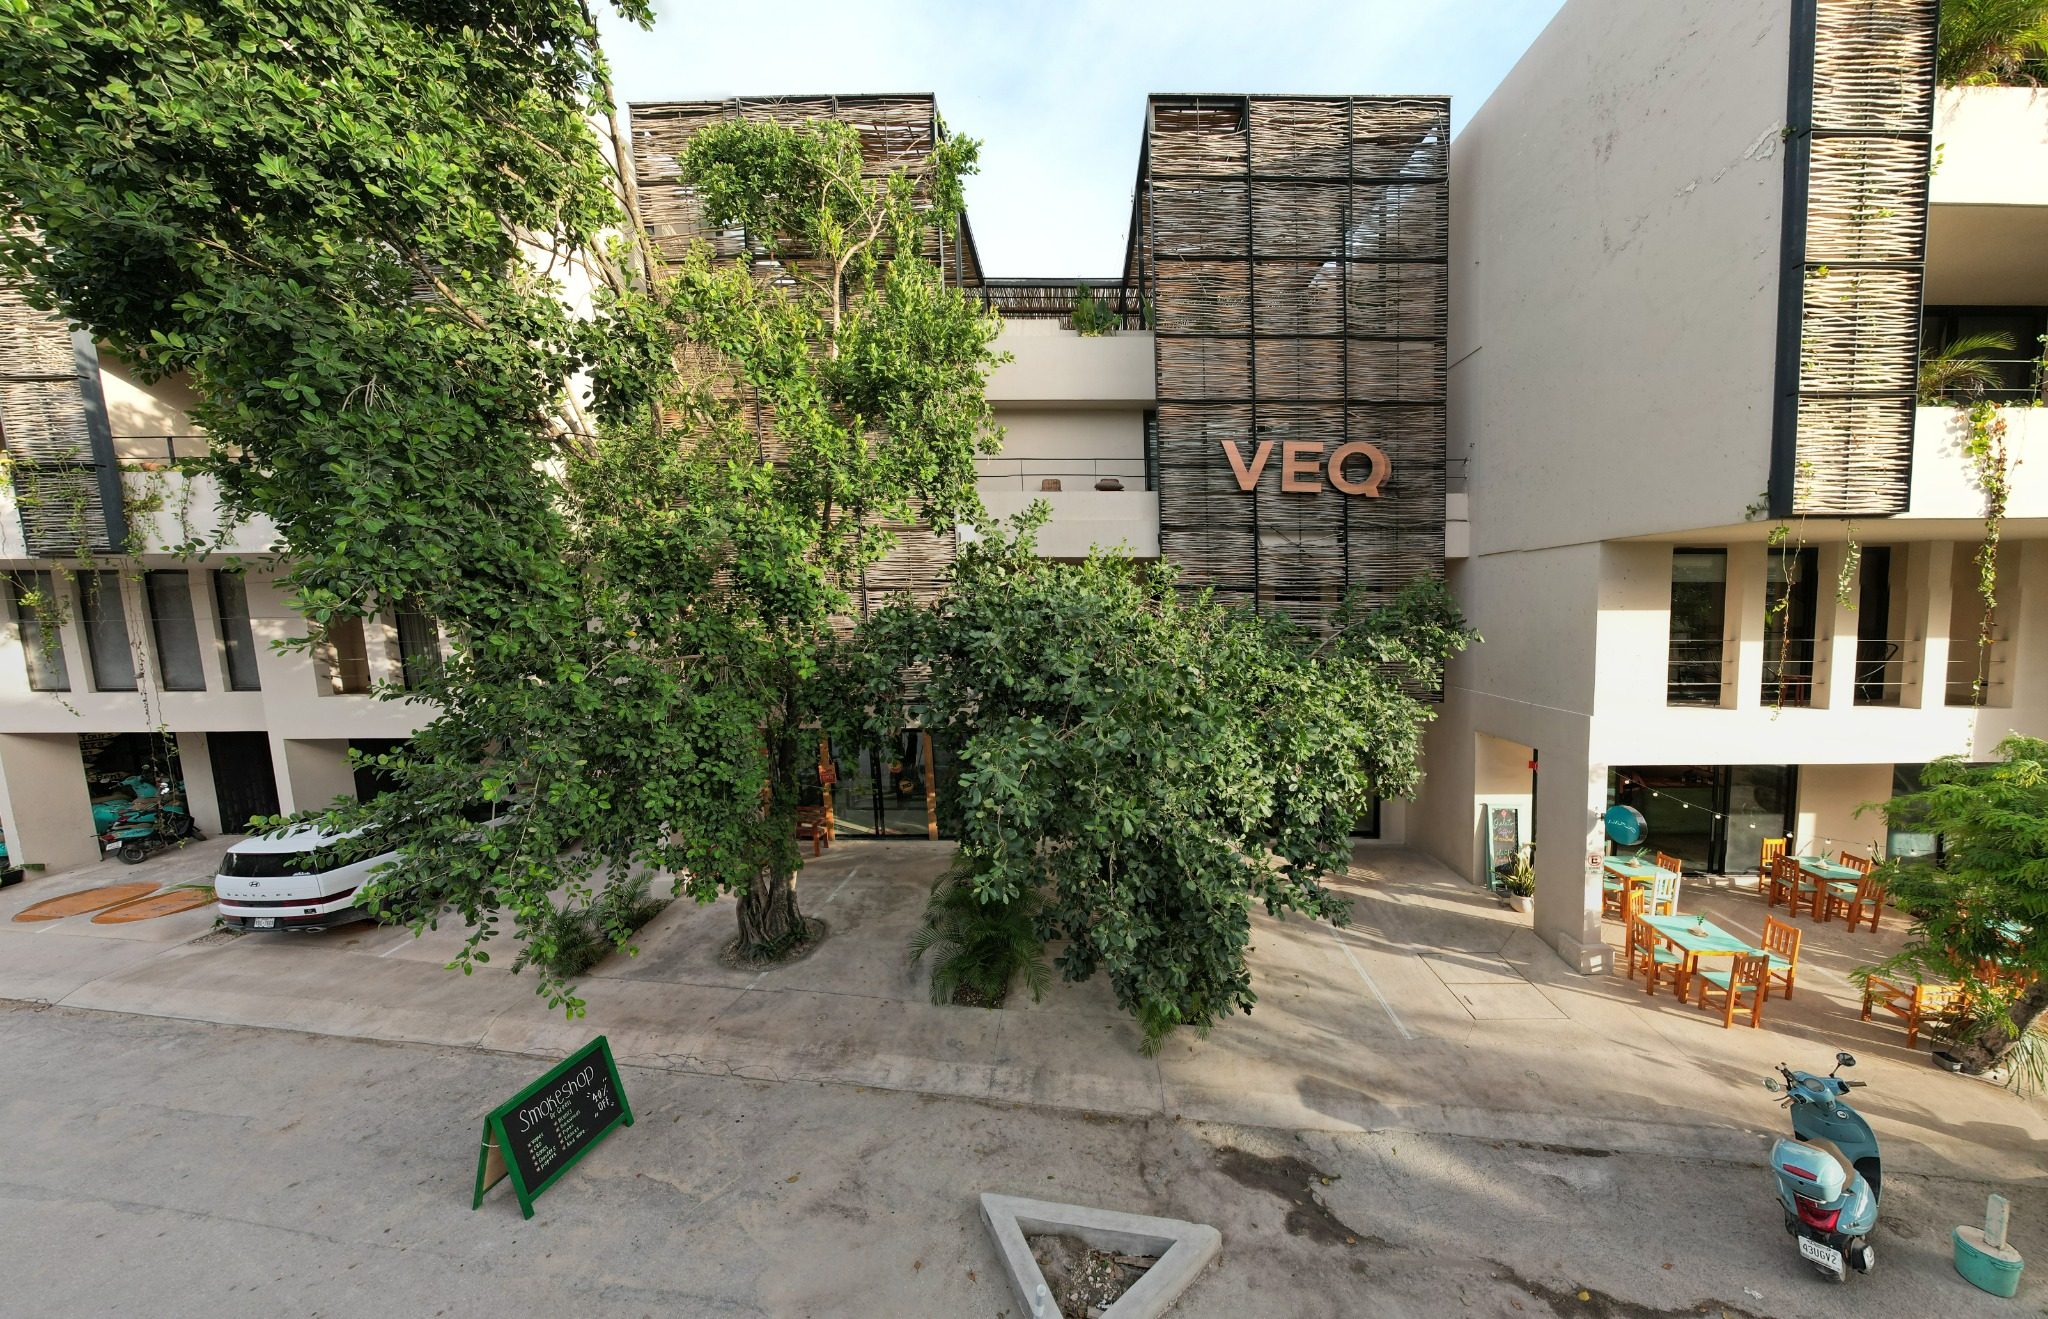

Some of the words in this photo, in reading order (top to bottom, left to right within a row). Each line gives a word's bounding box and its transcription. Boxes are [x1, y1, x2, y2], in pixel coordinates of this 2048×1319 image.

[1220, 440, 1389, 498] VEQ
[519, 1066, 594, 1133] Smokeshop
[597, 1097, 610, 1111] OFF
